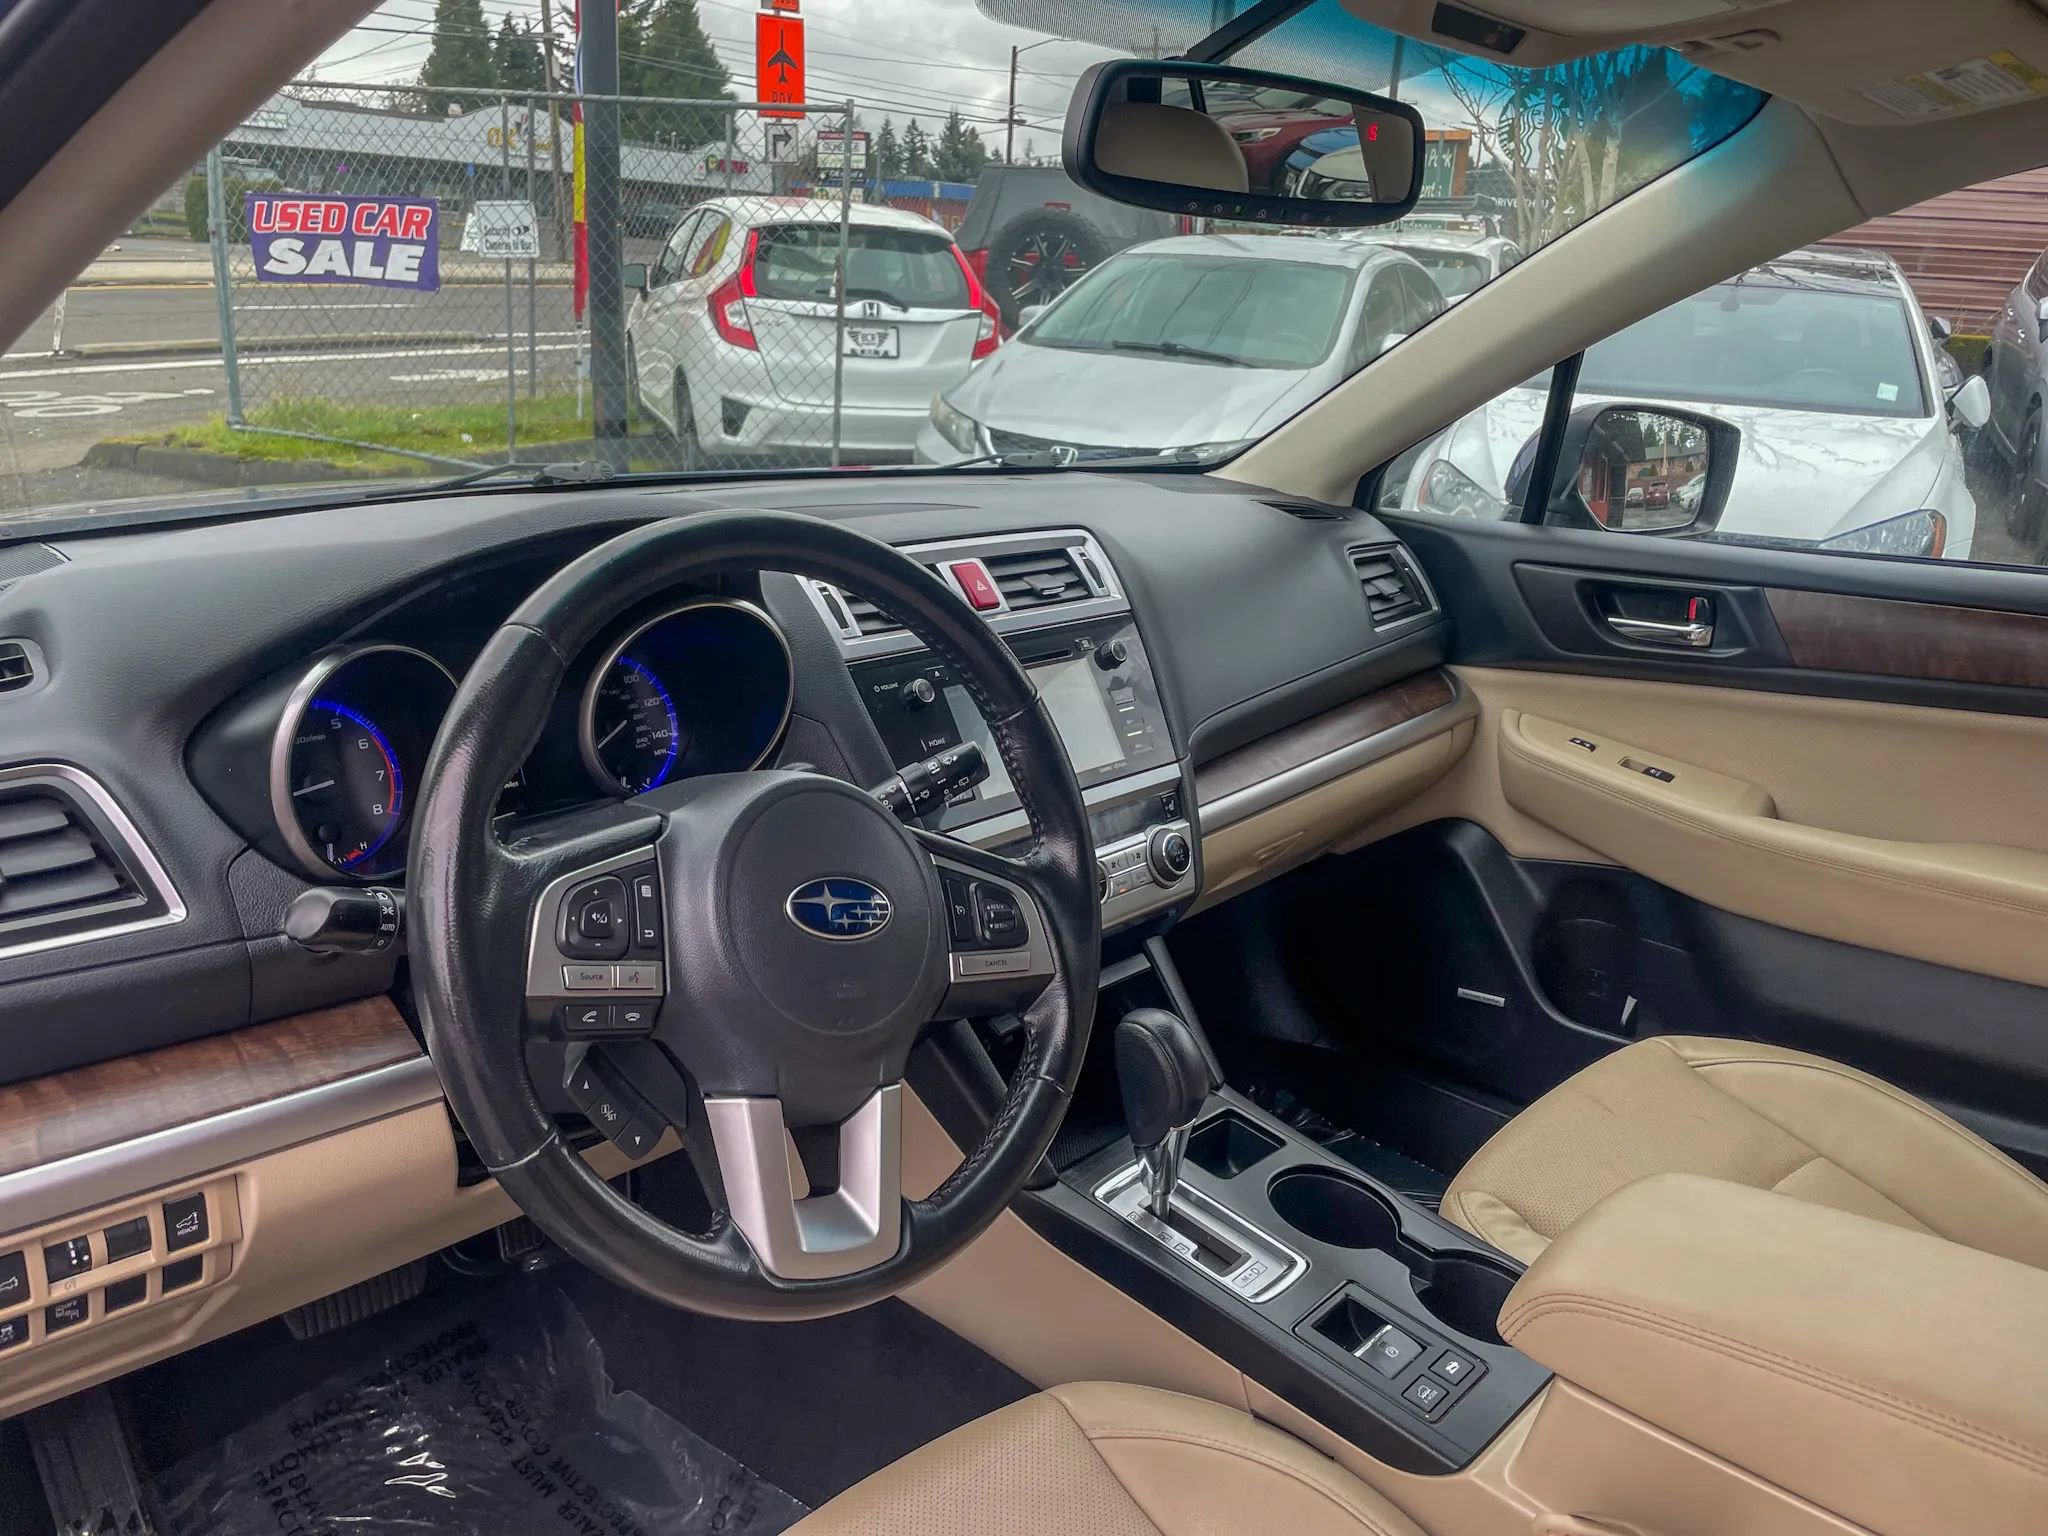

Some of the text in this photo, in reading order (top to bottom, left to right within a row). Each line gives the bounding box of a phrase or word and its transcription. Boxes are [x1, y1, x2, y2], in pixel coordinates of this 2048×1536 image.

[253, 201, 432, 240] USED CAR
[263, 238, 425, 282] SALE
[644, 697, 660, 708] 120
[330, 717, 342, 730] 5
[652, 729, 669, 740] 140
[358, 738, 369, 750] 6
[928, 736, 946, 748] HOME
[375, 769, 385, 782] 7
[372, 803, 384, 815] 8
[381, 923, 396, 931] AUTO
[580, 972, 604, 981] Source
[177, 1224, 199, 1236] MEMORY
